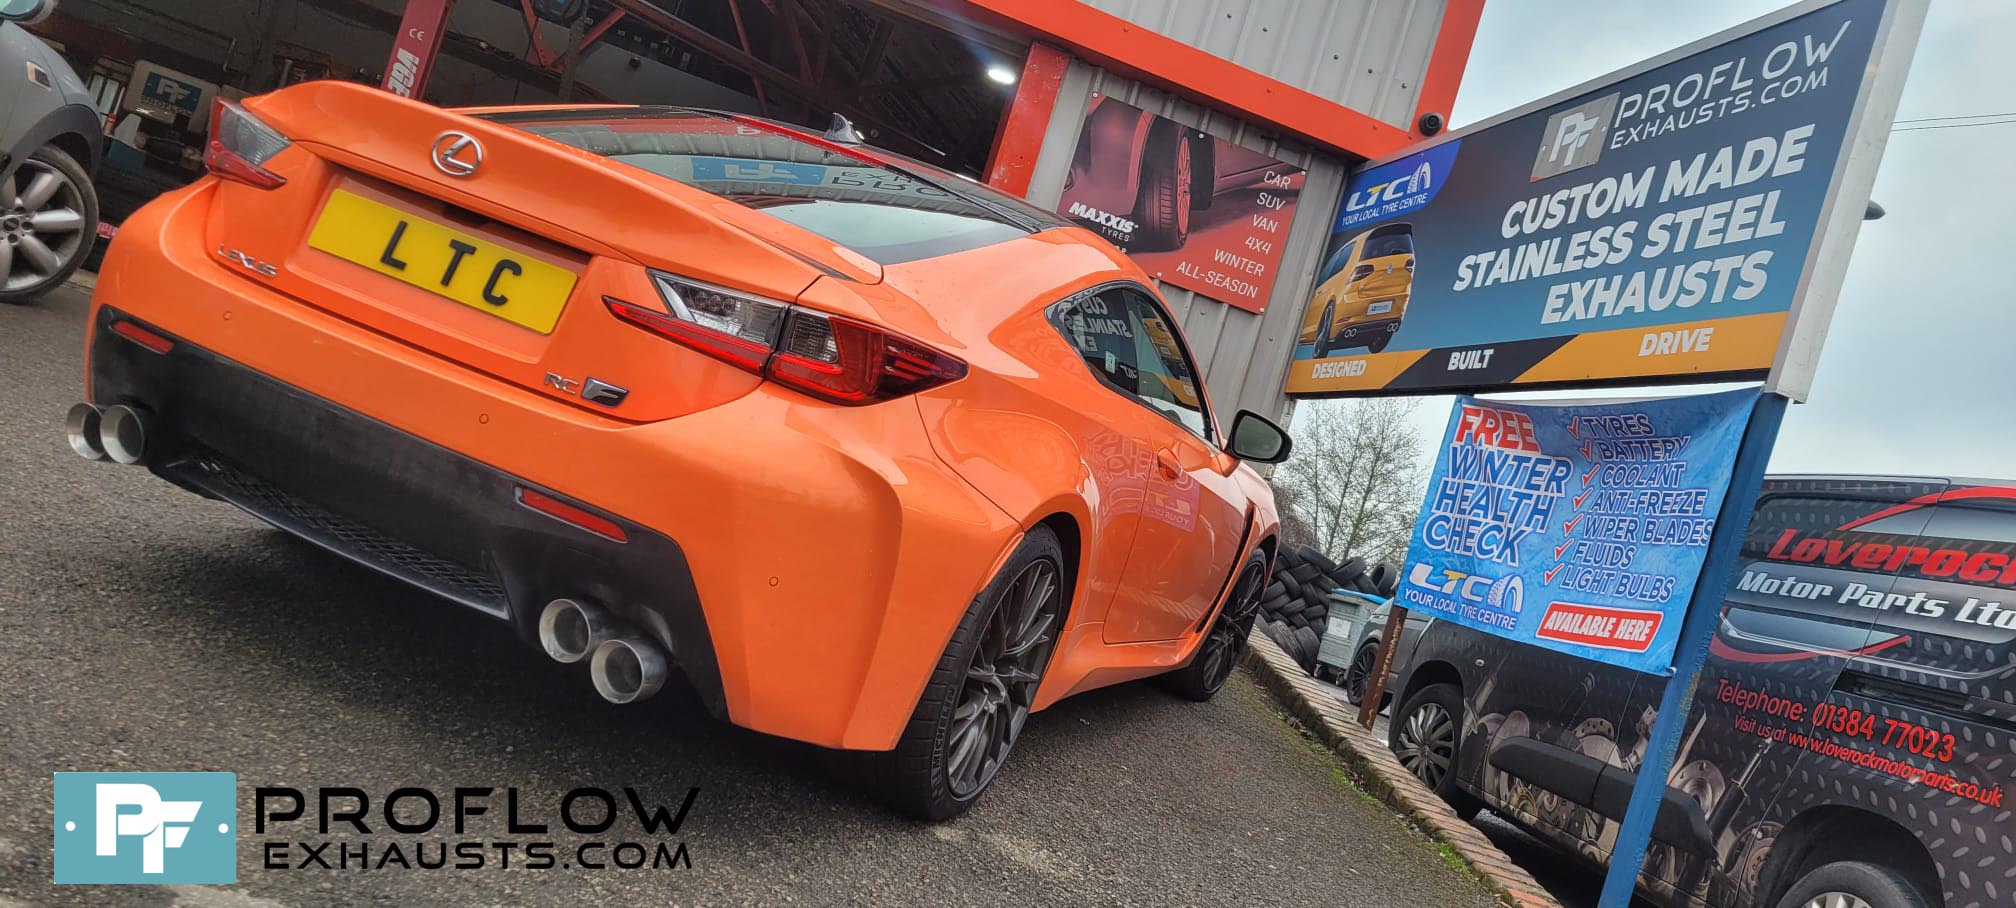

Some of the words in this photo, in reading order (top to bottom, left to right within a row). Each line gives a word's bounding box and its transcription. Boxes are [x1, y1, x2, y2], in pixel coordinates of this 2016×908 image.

[1614, 20, 1852, 128] PROFLOW
[1610, 66, 1829, 149] EXHAUSTS.COM
[1264, 170, 1291, 190] CAR
[1346, 174, 1412, 212] LTC
[1501, 166, 1656, 239] CUSTOM
[1659, 123, 1815, 204] MADE
[1069, 202, 1135, 233] MAXXIS
[1256, 192, 1286, 211] SUV
[1342, 212, 1359, 226] YOUR
[1359, 207, 1380, 221] LOCAL
[1382, 201, 1399, 215] TYRE
[1399, 192, 1428, 210] CENTRE
[1102, 226, 1130, 242] TYRES
[1253, 214, 1278, 233] VAN
[1453, 220, 1638, 291] STAINLESS
[1641, 190, 1786, 259] STEEL
[217, 243, 277, 277] LEXUS
[1244, 235, 1272, 255] 4X4
[1176, 260, 1259, 299] ALL-SEASON
[1214, 249, 1265, 277] WINTER
[1540, 250, 1774, 324] EXHAUSTS
[1638, 327, 1714, 357] DRIVE
[1312, 359, 1367, 379] DESIGNED
[1448, 349, 1494, 371] BUILT
[544, 371, 579, 395] RC
[1454, 404, 1541, 455] FREE
[1582, 413, 1655, 438] TYRES
[1599, 436, 1691, 462] BATTERY
[1450, 443, 1573, 497] WINTER
[1601, 462, 1686, 488] COOLANT
[1432, 478, 1556, 533] HEALTH
[1590, 489, 1708, 516] ANTI-FREEZE
[1423, 513, 1532, 567] CHECK
[1583, 515, 1639, 543] WIPER
[1641, 517, 1714, 547] BLADES
[1571, 541, 1637, 569] FLUIDS
[1409, 562, 1491, 603] LTC
[1560, 565, 1612, 594] LIGHT
[1612, 572, 1676, 603] BULBS
[1736, 570, 1833, 601] Motor
[1838, 582, 1949, 618] Parts
[1404, 587, 1433, 606] YOUR
[1433, 596, 1456, 614] LOCAL
[1459, 602, 1477, 620] TYRE
[1477, 610, 1517, 631] CENTRE
[1544, 610, 1614, 638] AVAILABLE
[1613, 619, 1654, 642] HERE
[1715, 679, 1807, 723] Telephone:
[1811, 702, 1877, 741] 01384
[1882, 719, 1956, 763] 77023
[1734, 714, 1757, 732] Visit
[1757, 724, 1772, 738] us
[1774, 727, 1787, 742] at
[1788, 732, 2003, 808] www.loverockmotorparts.co.uk
